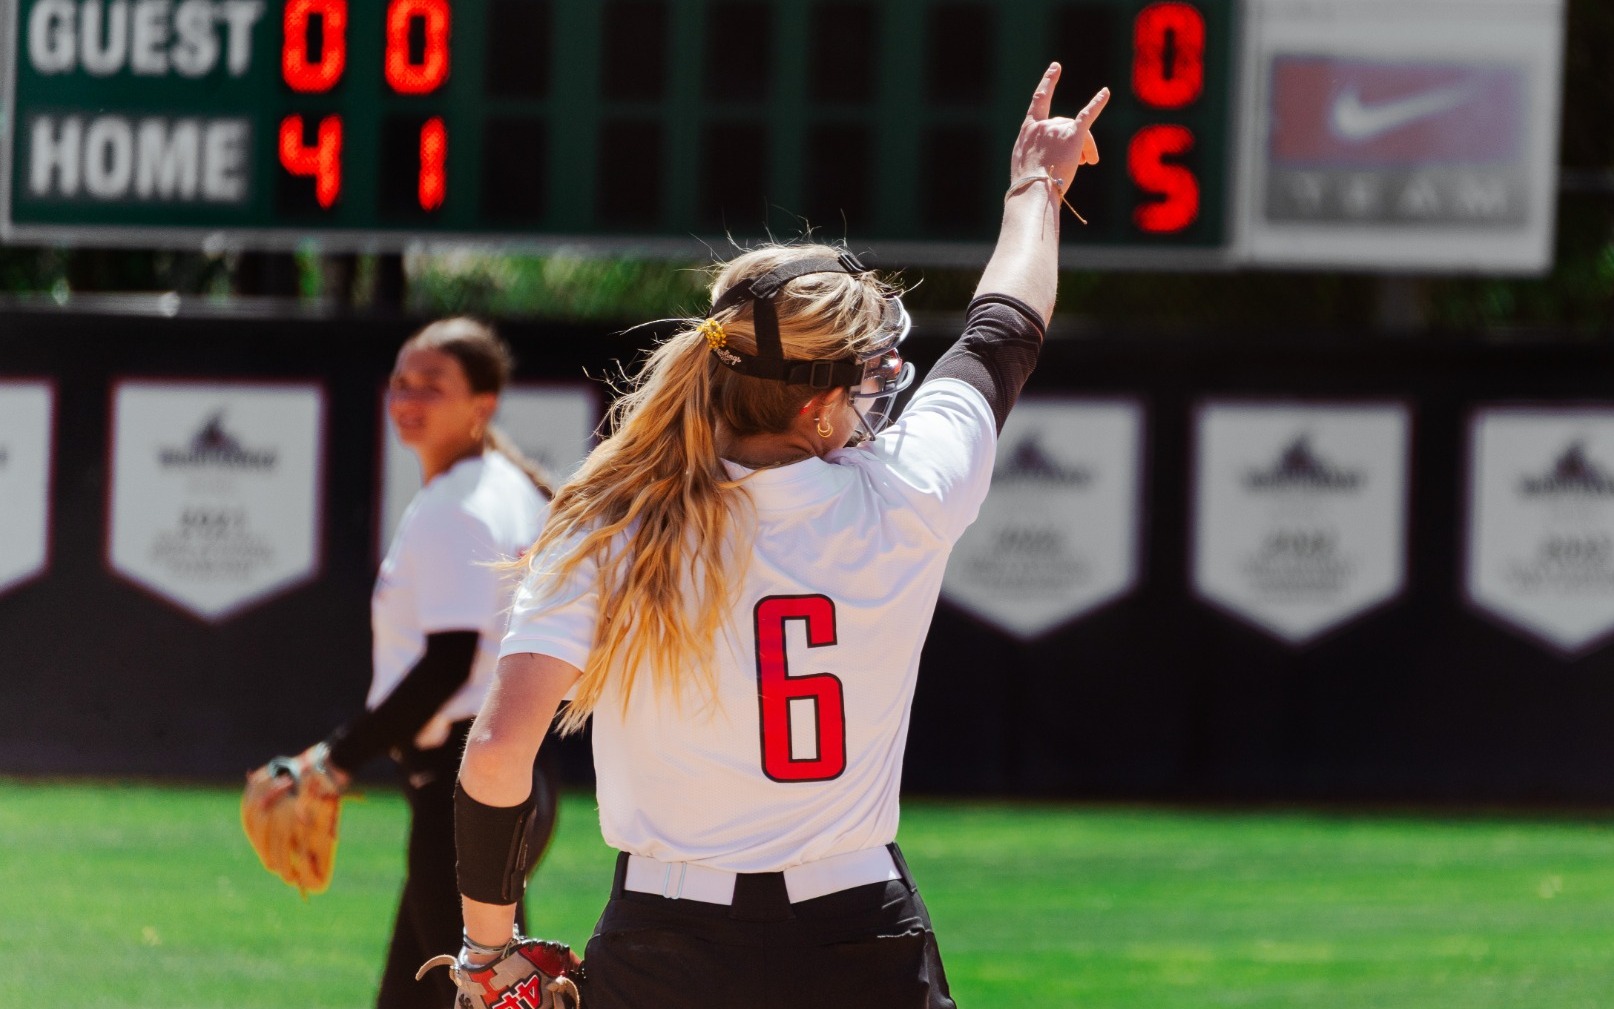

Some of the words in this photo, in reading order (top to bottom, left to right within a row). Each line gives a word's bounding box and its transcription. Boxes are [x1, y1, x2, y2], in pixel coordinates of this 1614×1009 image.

[28, 0, 260, 76] GUEST
[282, 0, 347, 93] 0
[384, 0, 451, 95] 0
[1131, 2, 1206, 109] 0
[28, 115, 249, 199] HOME
[278, 113, 343, 210] 4
[417, 115, 448, 212] 1
[753, 593, 847, 784] 6
